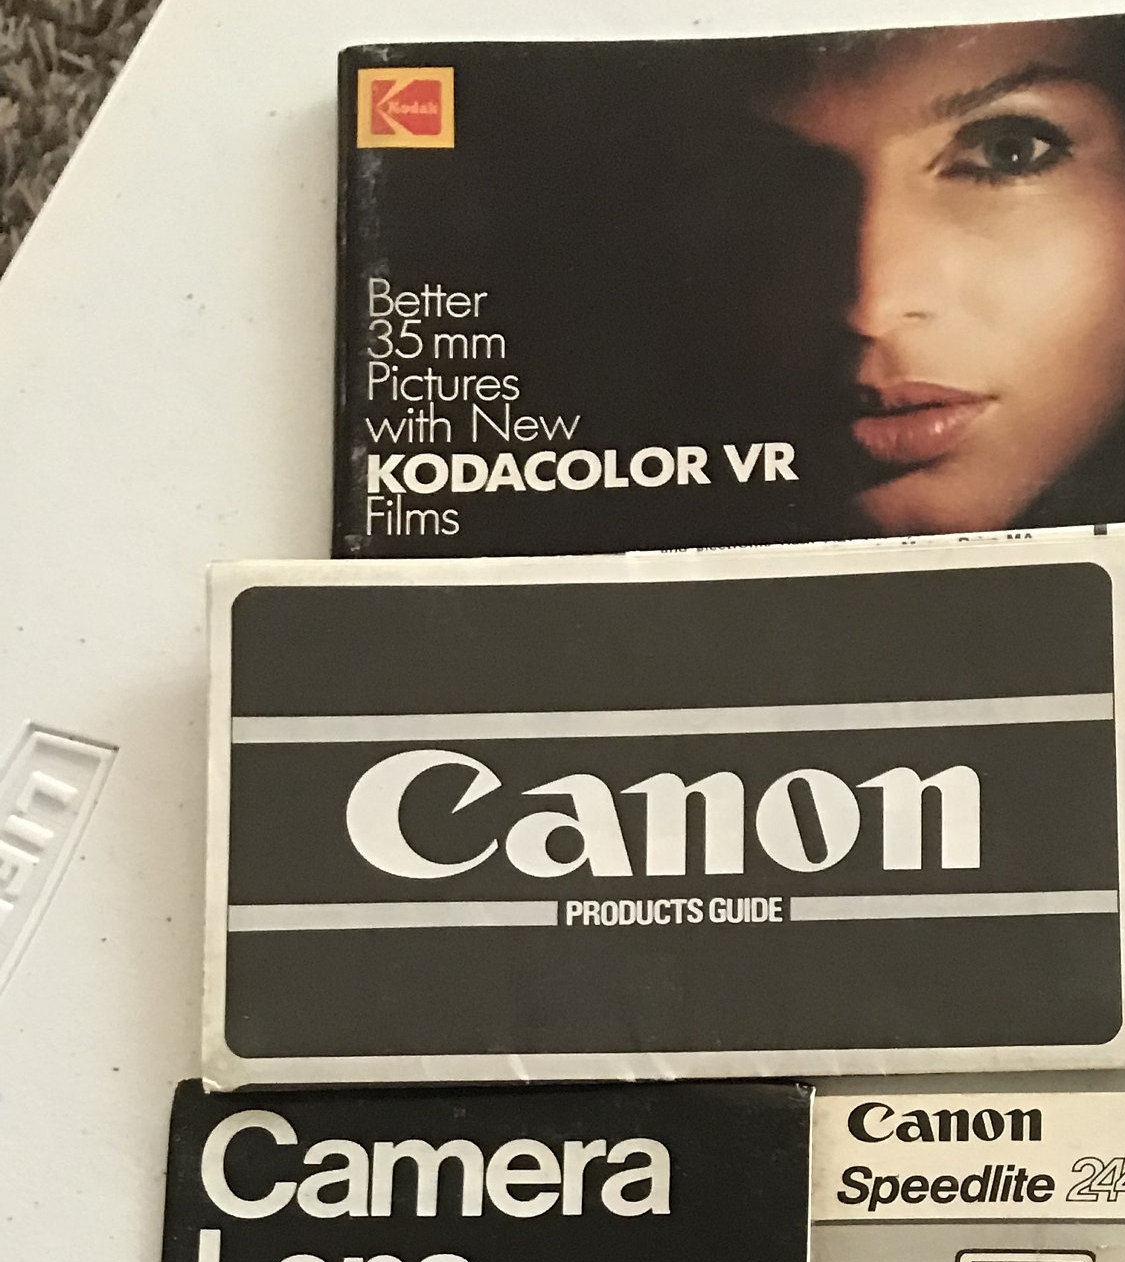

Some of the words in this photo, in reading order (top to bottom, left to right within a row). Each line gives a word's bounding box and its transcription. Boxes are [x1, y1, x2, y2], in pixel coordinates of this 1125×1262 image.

[387, 101, 438, 114] Kodak
[368, 278, 487, 318] Better
[368, 320, 424, 359] 35
[434, 332, 506, 359] mm
[368, 361, 520, 402] Pictures
[366, 402, 451, 444] with
[472, 403, 580, 442] New
[367, 447, 710, 493] KODACOLOR
[723, 442, 799, 482] VR
[366, 494, 460, 535] Films
[345, 748, 982, 880] Canon
[565, 898, 704, 929] PRODUCTS
[709, 896, 784, 925] GUIDE
[847, 1102, 1043, 1143] Canon
[200, 1109, 671, 1219] Camera
[837, 1164, 1056, 1212] Speedlite
